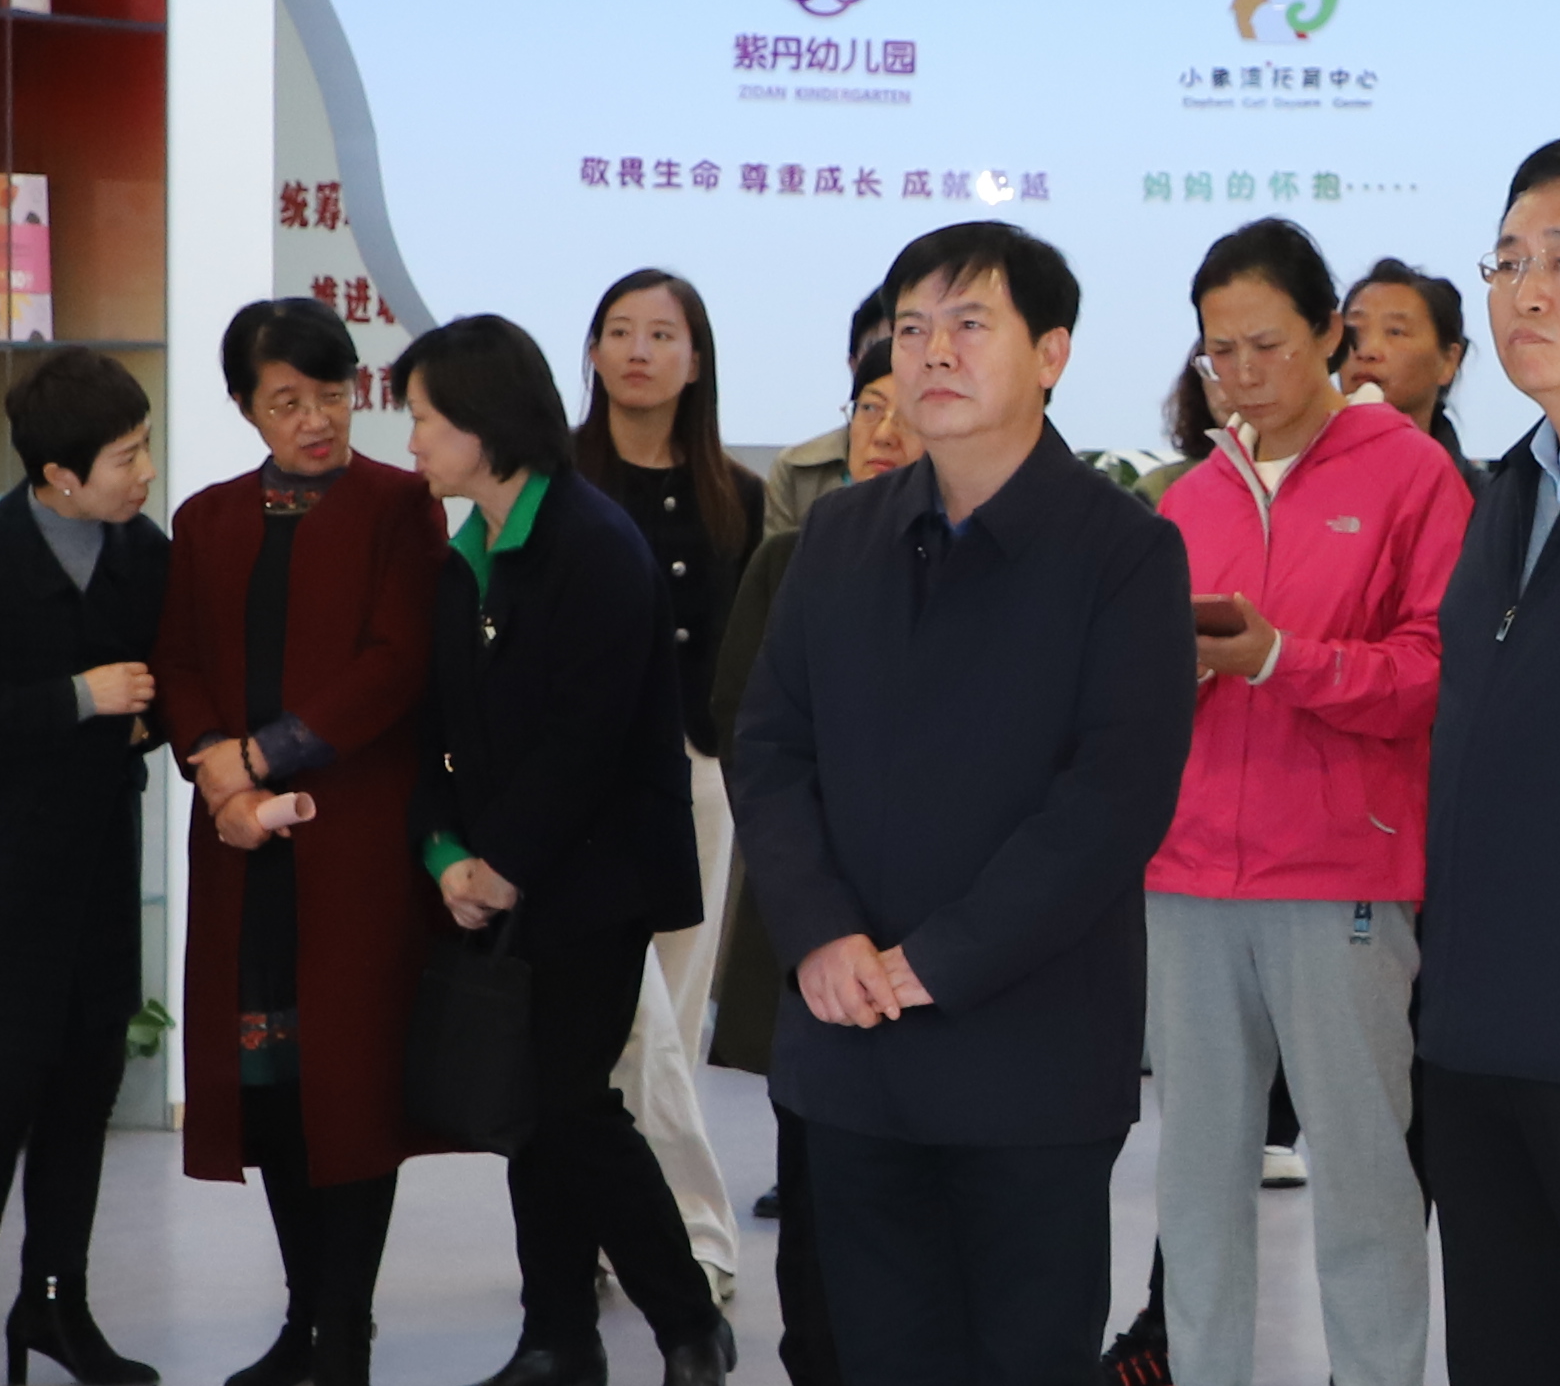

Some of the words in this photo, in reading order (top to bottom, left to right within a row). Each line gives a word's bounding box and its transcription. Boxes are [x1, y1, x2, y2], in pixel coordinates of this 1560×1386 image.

[733, 33, 916, 74] 紫丹幼儿园
[738, 84, 787, 100] ZIDAN
[794, 86, 912, 104] KINDERGARTEN
[579, 156, 722, 191] 敬畏生命
[738, 162, 883, 198] 尊重成长
[901, 168, 1050, 203] 成就越
